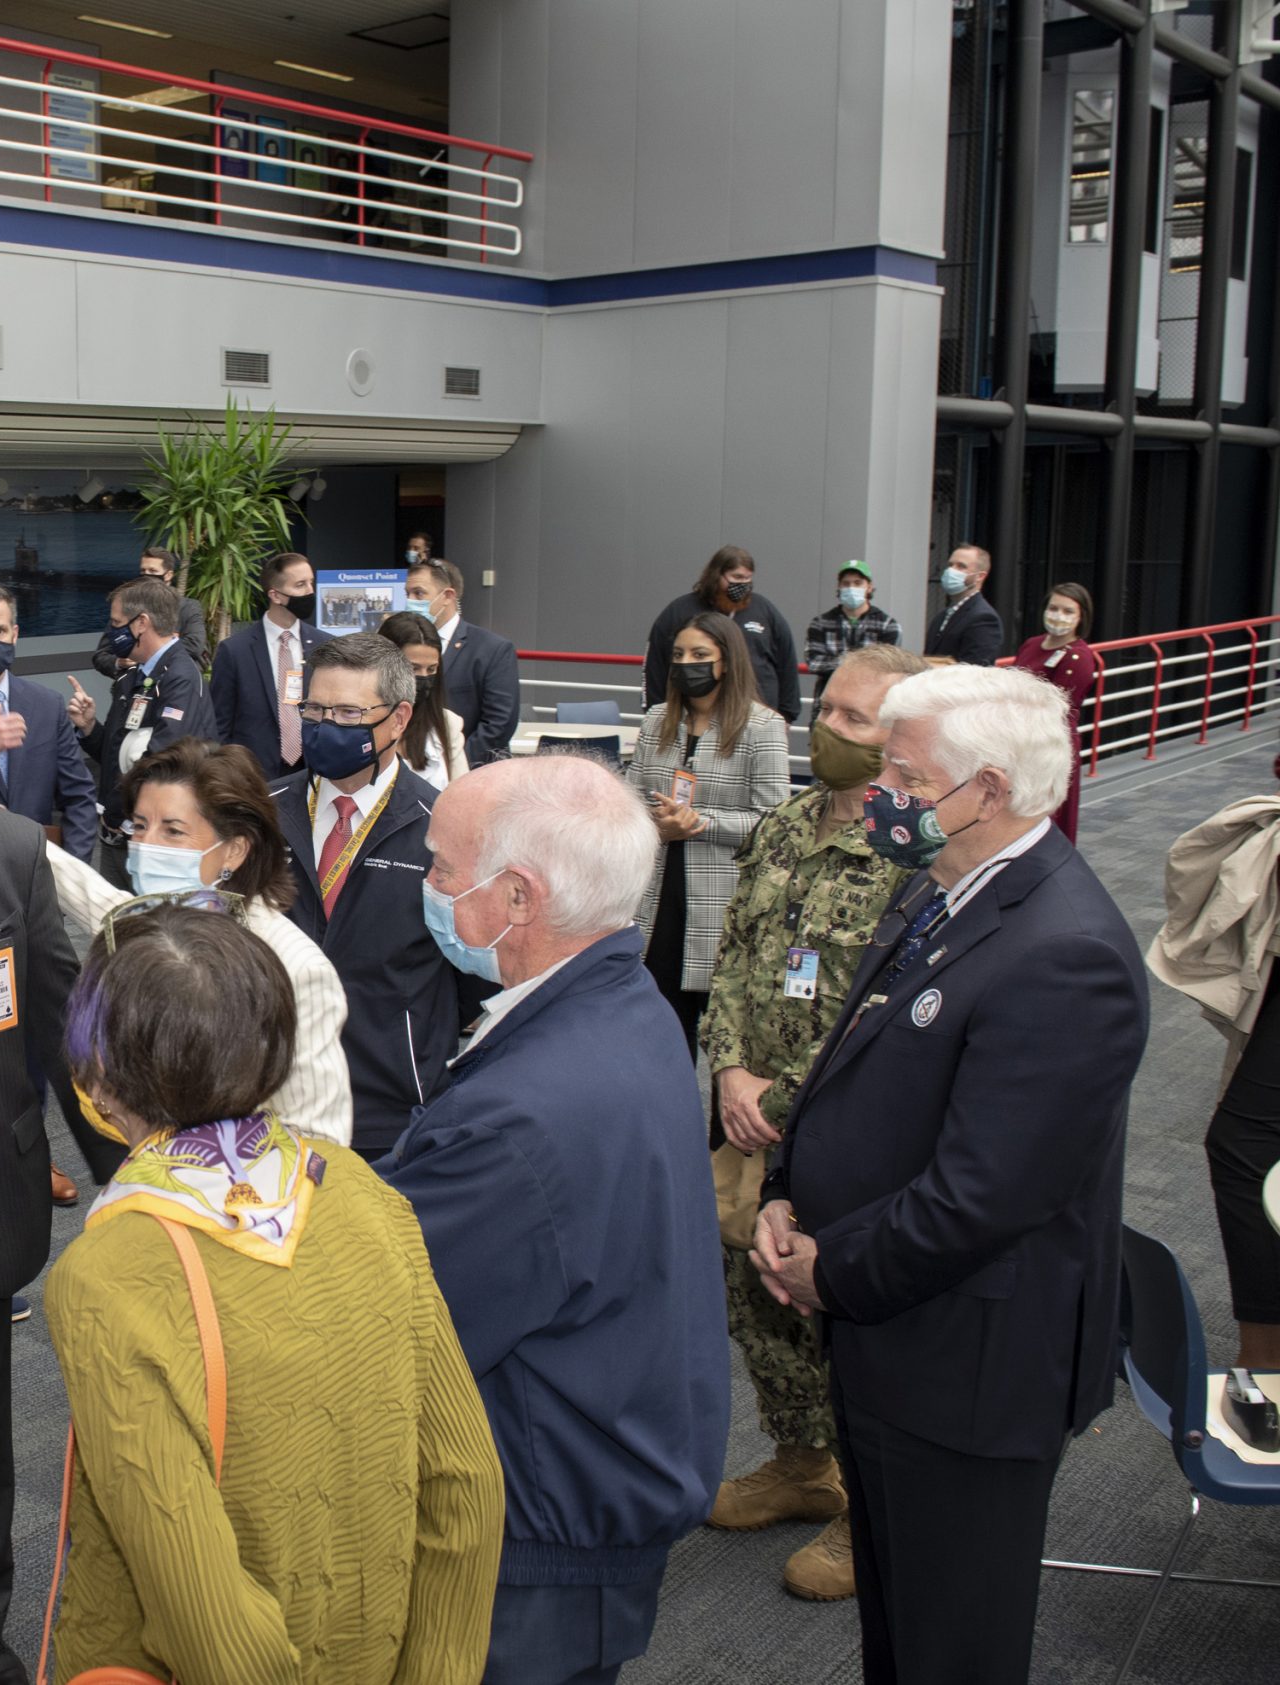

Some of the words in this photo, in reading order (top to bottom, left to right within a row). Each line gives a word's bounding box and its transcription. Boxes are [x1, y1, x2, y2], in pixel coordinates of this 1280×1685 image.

[338, 573, 373, 582] Quonset
[375, 572, 398, 580] Point
[393, 861, 424, 871] DYNAMICS
[845, 891, 873, 908] NAVY
